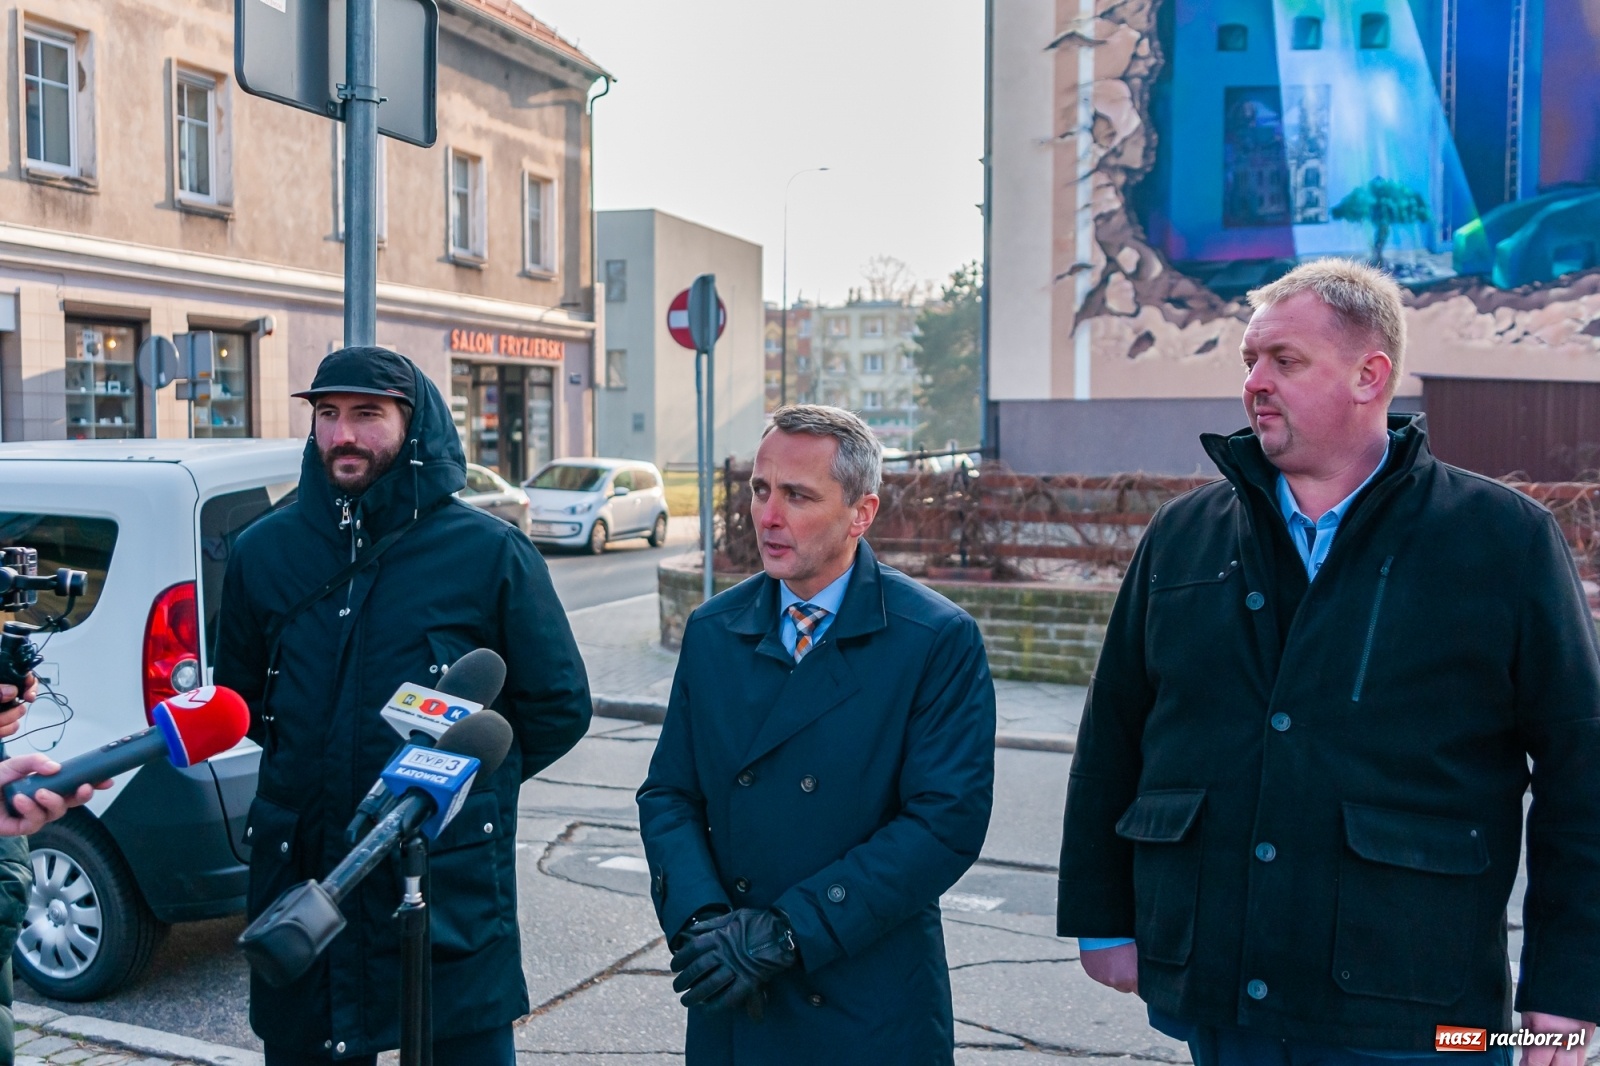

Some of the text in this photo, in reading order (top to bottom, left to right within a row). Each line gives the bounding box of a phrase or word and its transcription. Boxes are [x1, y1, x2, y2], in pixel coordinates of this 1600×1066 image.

[451, 328, 565, 360] SALON FRYZJERSKI
[402, 693, 464, 720] RTK
[415, 753, 461, 771] TVP 3
[395, 767, 449, 784] KATOWICE
